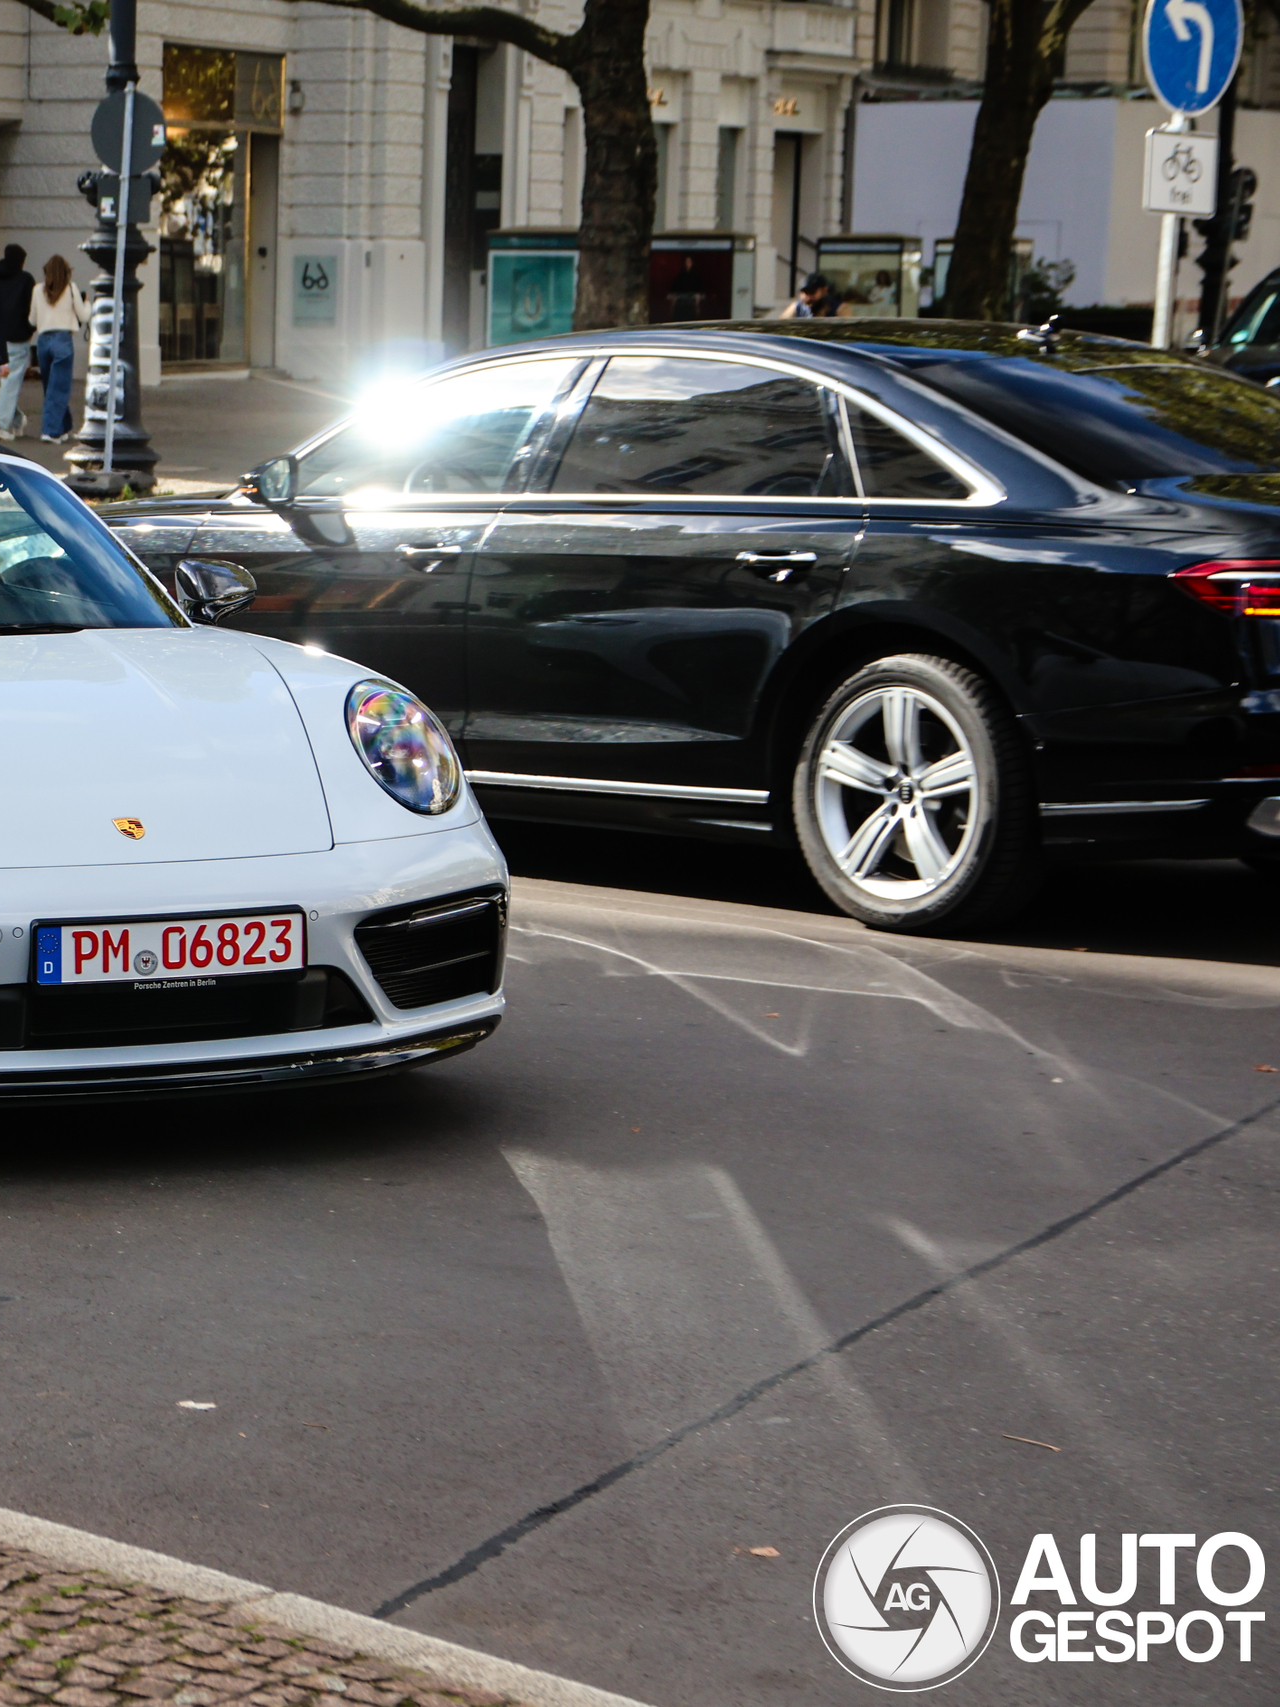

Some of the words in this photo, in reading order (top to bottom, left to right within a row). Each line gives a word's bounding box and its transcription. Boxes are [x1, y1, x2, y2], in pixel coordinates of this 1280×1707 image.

[1170, 187, 1193, 204] frei
[72, 929, 129, 974] PM
[162, 919, 292, 969] 06823
[44, 962, 53, 974] D
[134, 982, 162, 990] Porsche
[162, 980, 189, 989] Zentren
[189, 979, 196, 987] in
[197, 978, 217, 987] Berlin
